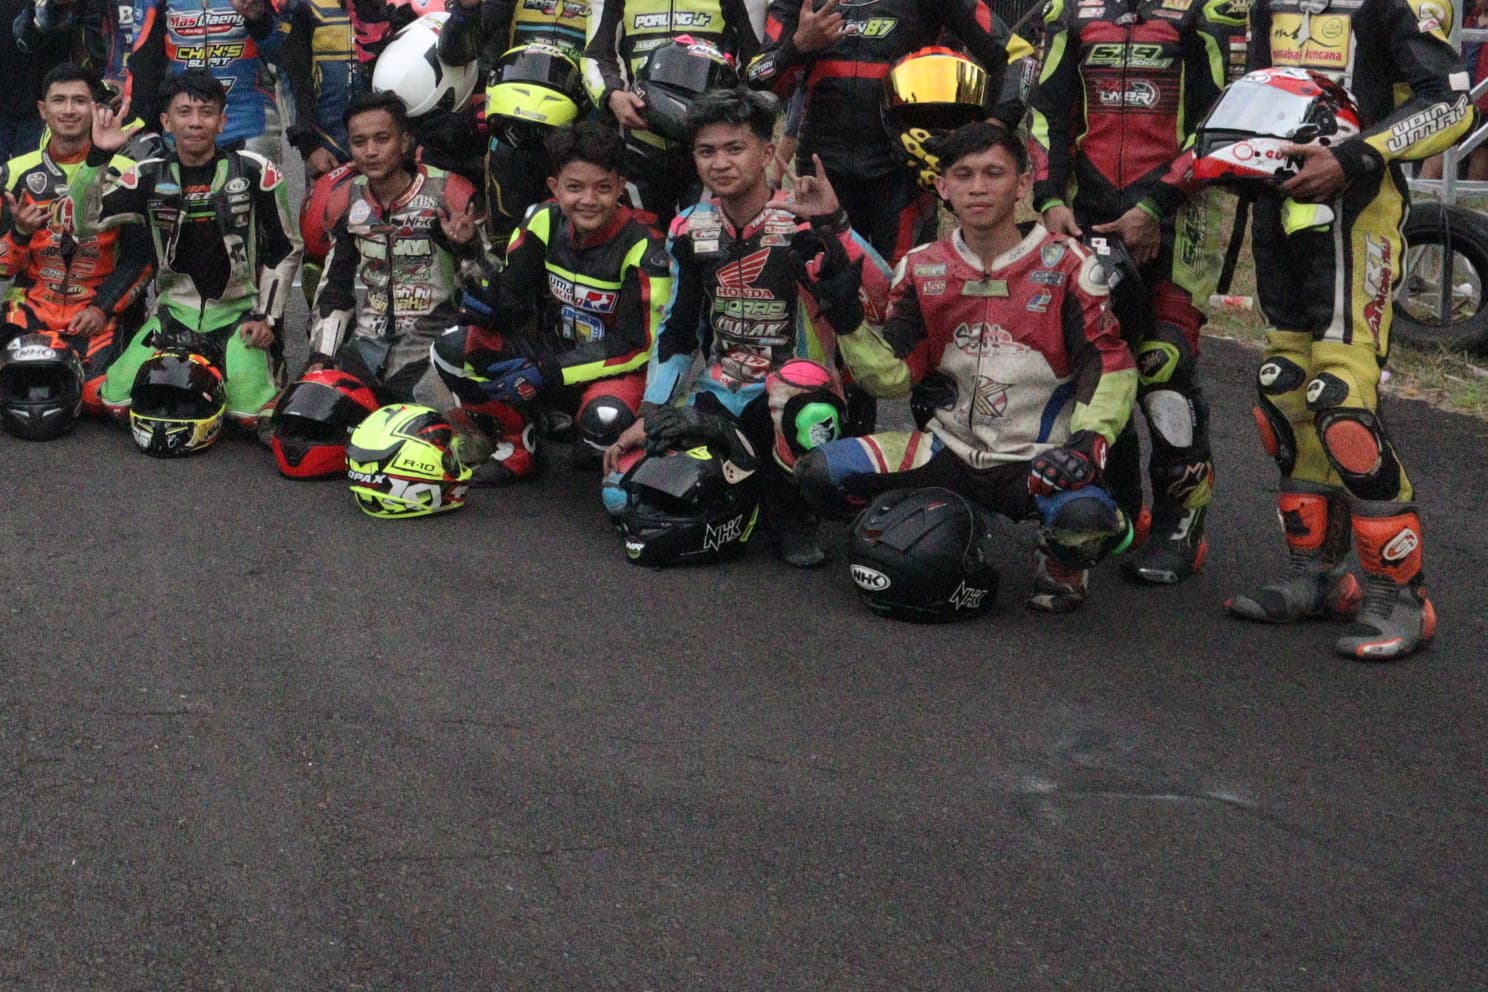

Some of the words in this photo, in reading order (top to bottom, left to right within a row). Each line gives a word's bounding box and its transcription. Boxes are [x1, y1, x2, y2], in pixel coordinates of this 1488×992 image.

[717, 288, 774, 299] HONDA
[402, 458, 435, 472] R-10
[703, 514, 743, 552] NHK
[852, 568, 881, 587] NHK
[948, 579, 989, 611] NHK
